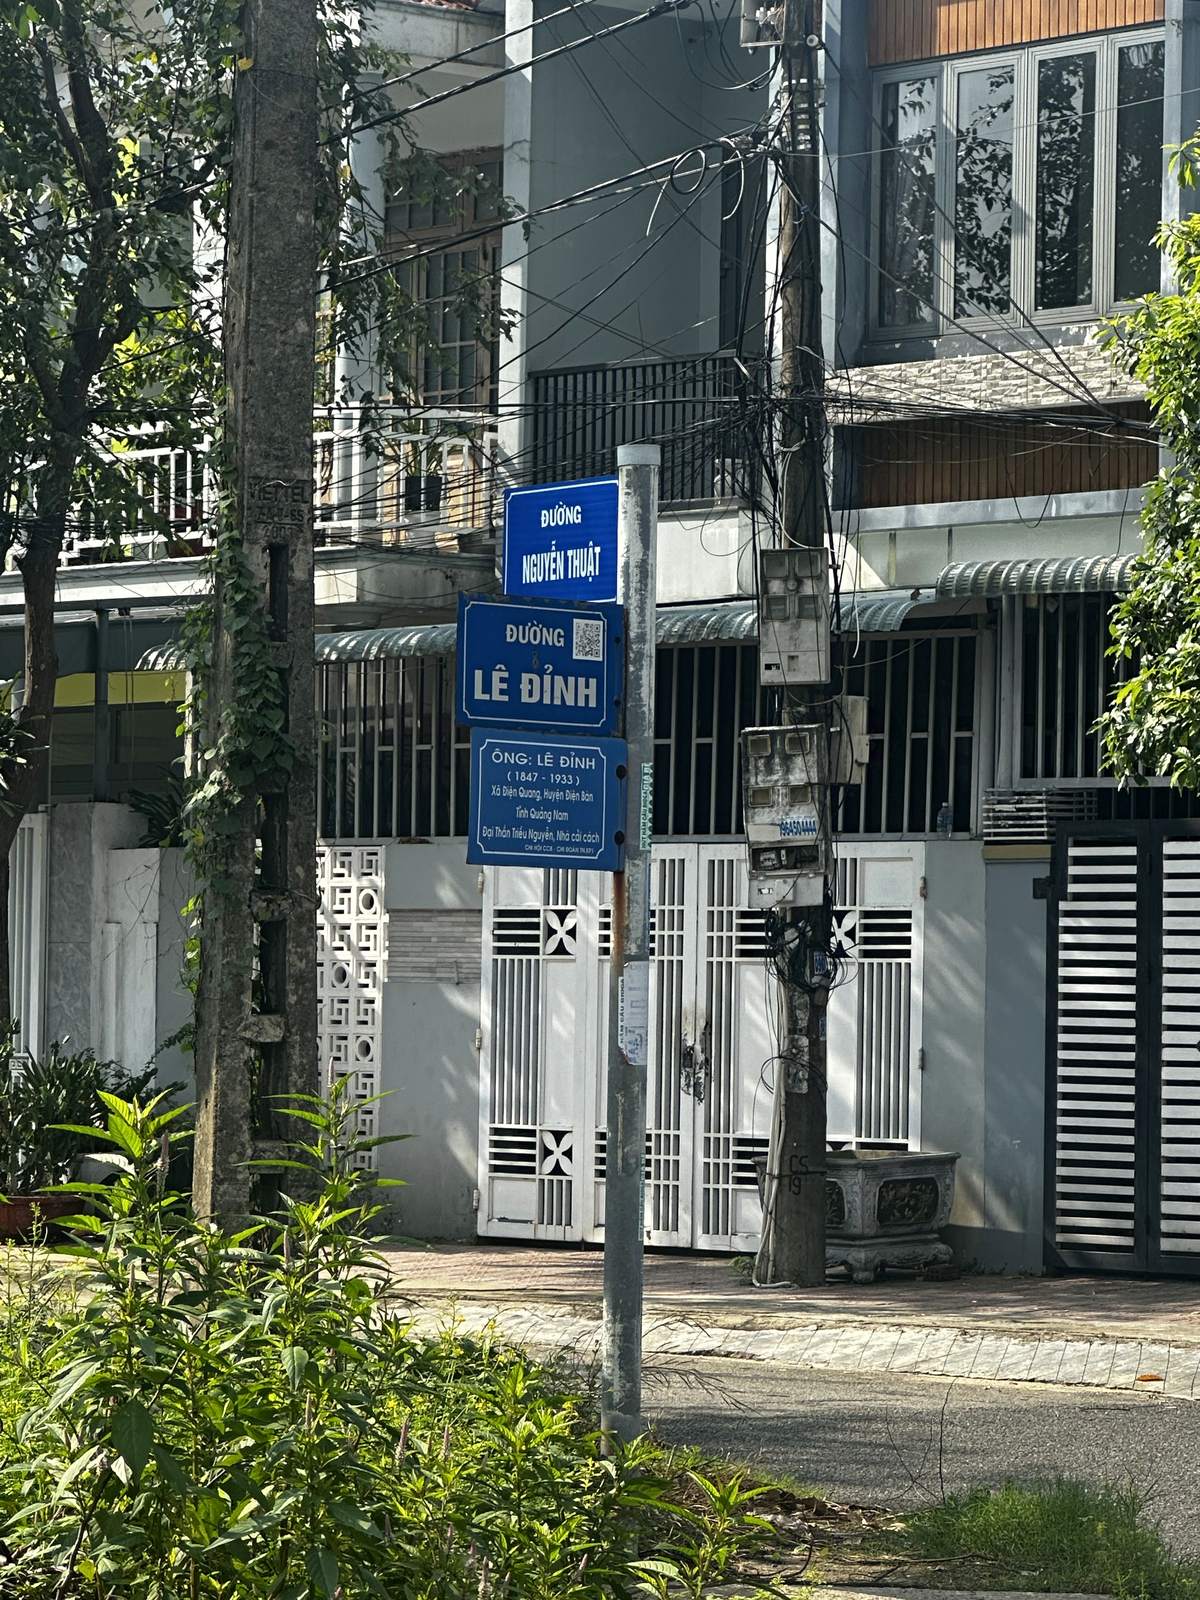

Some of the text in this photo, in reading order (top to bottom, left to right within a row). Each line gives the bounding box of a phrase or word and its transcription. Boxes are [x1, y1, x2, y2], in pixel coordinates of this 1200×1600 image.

[541, 501, 582, 528] ĐƯỜNG
[522, 540, 601, 584] NGUYỄN THUẬT
[505, 620, 565, 647] ĐƯỜNG
[474, 664, 597, 708] LÊ ĐỈNH
[491, 748, 596, 769] ÔNG: LÊ ĐỈNH
[502, 785, 517, 799] Điện
[543, 788, 564, 803] Huyện
[565, 789, 580, 803] Điện
[530, 807, 552, 822] Quảng
[553, 809, 569, 821] Nam
[482, 825, 494, 840] Đại
[583, 831, 600, 843] cách
[789, 1154, 809, 1174] CS
